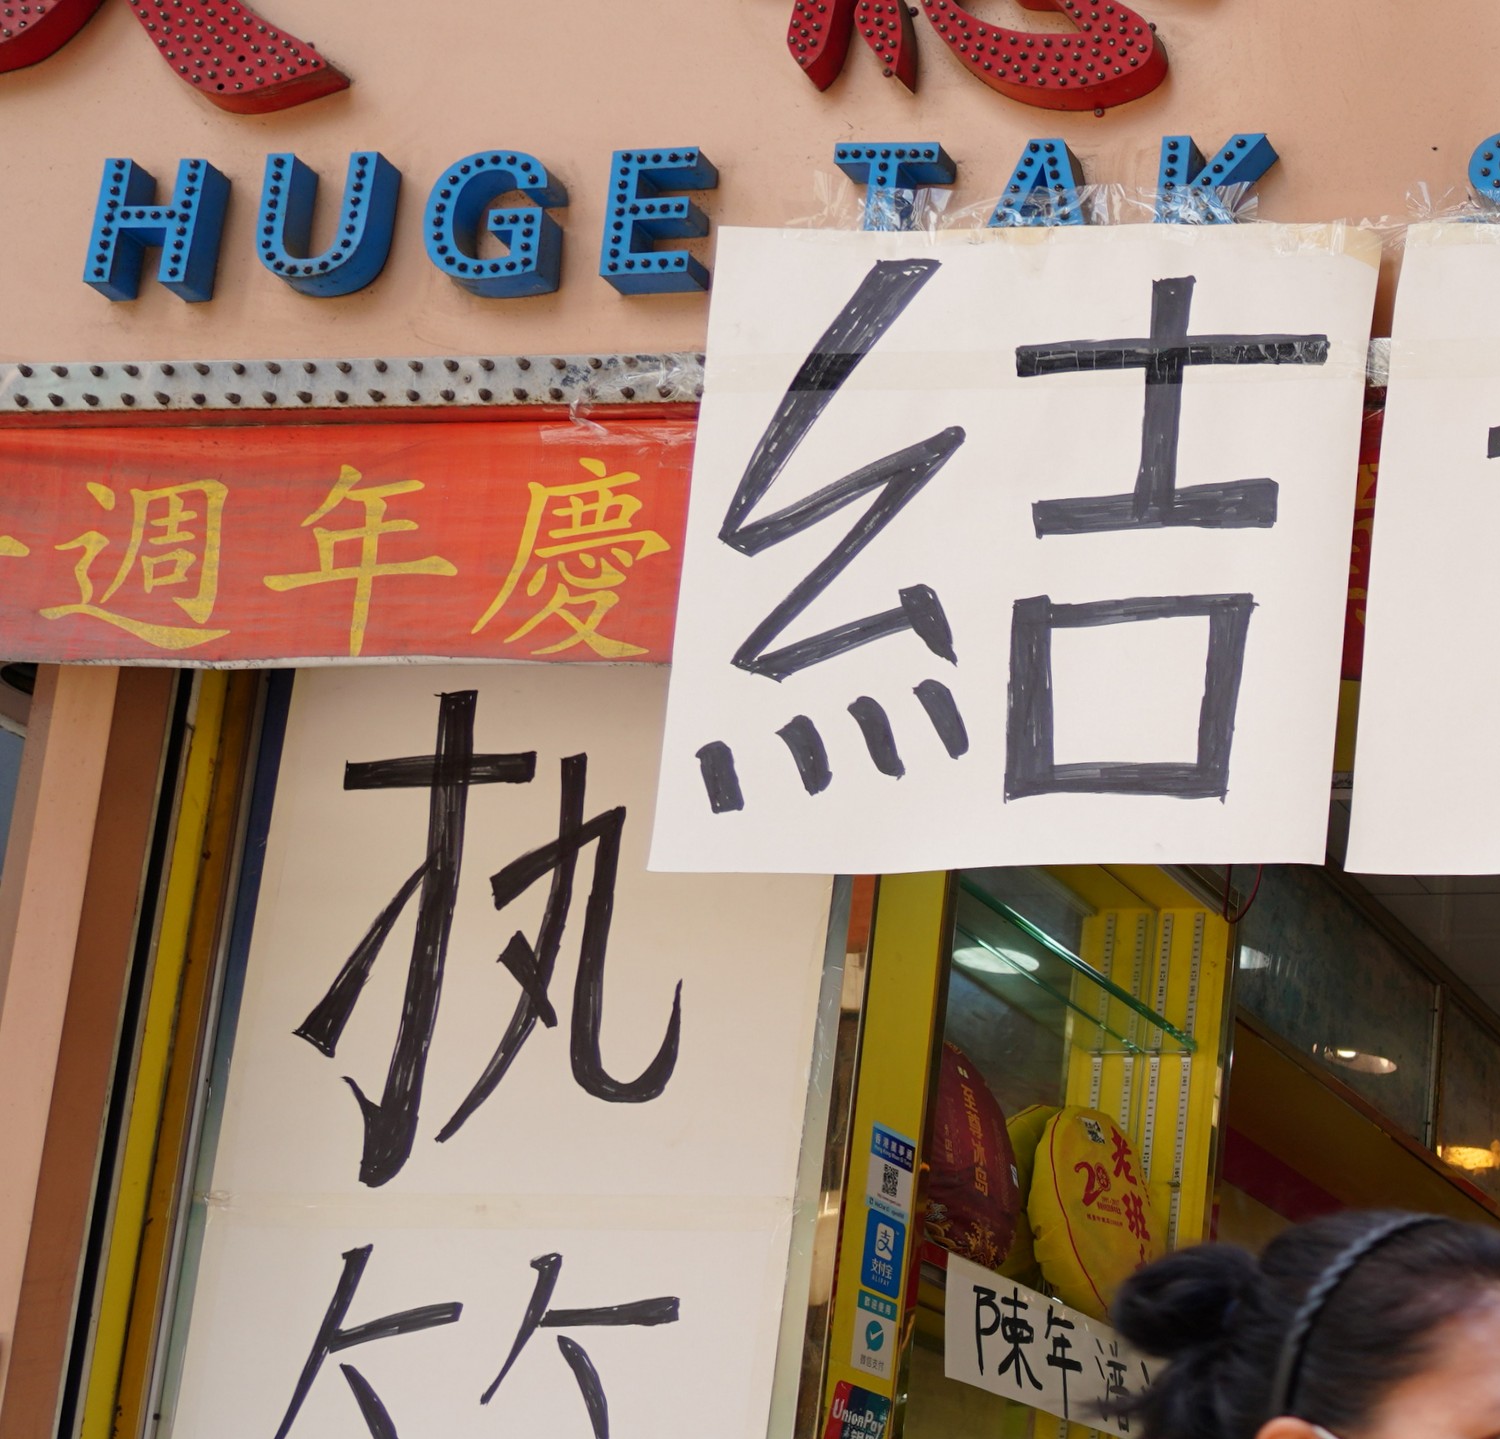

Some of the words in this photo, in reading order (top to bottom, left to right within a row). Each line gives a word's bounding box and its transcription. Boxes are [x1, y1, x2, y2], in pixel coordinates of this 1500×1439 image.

[82, 145, 720, 303] HUGE
[833, 133, 1281, 229] TAK
[870, 1258, 894, 1281] 支付宝
